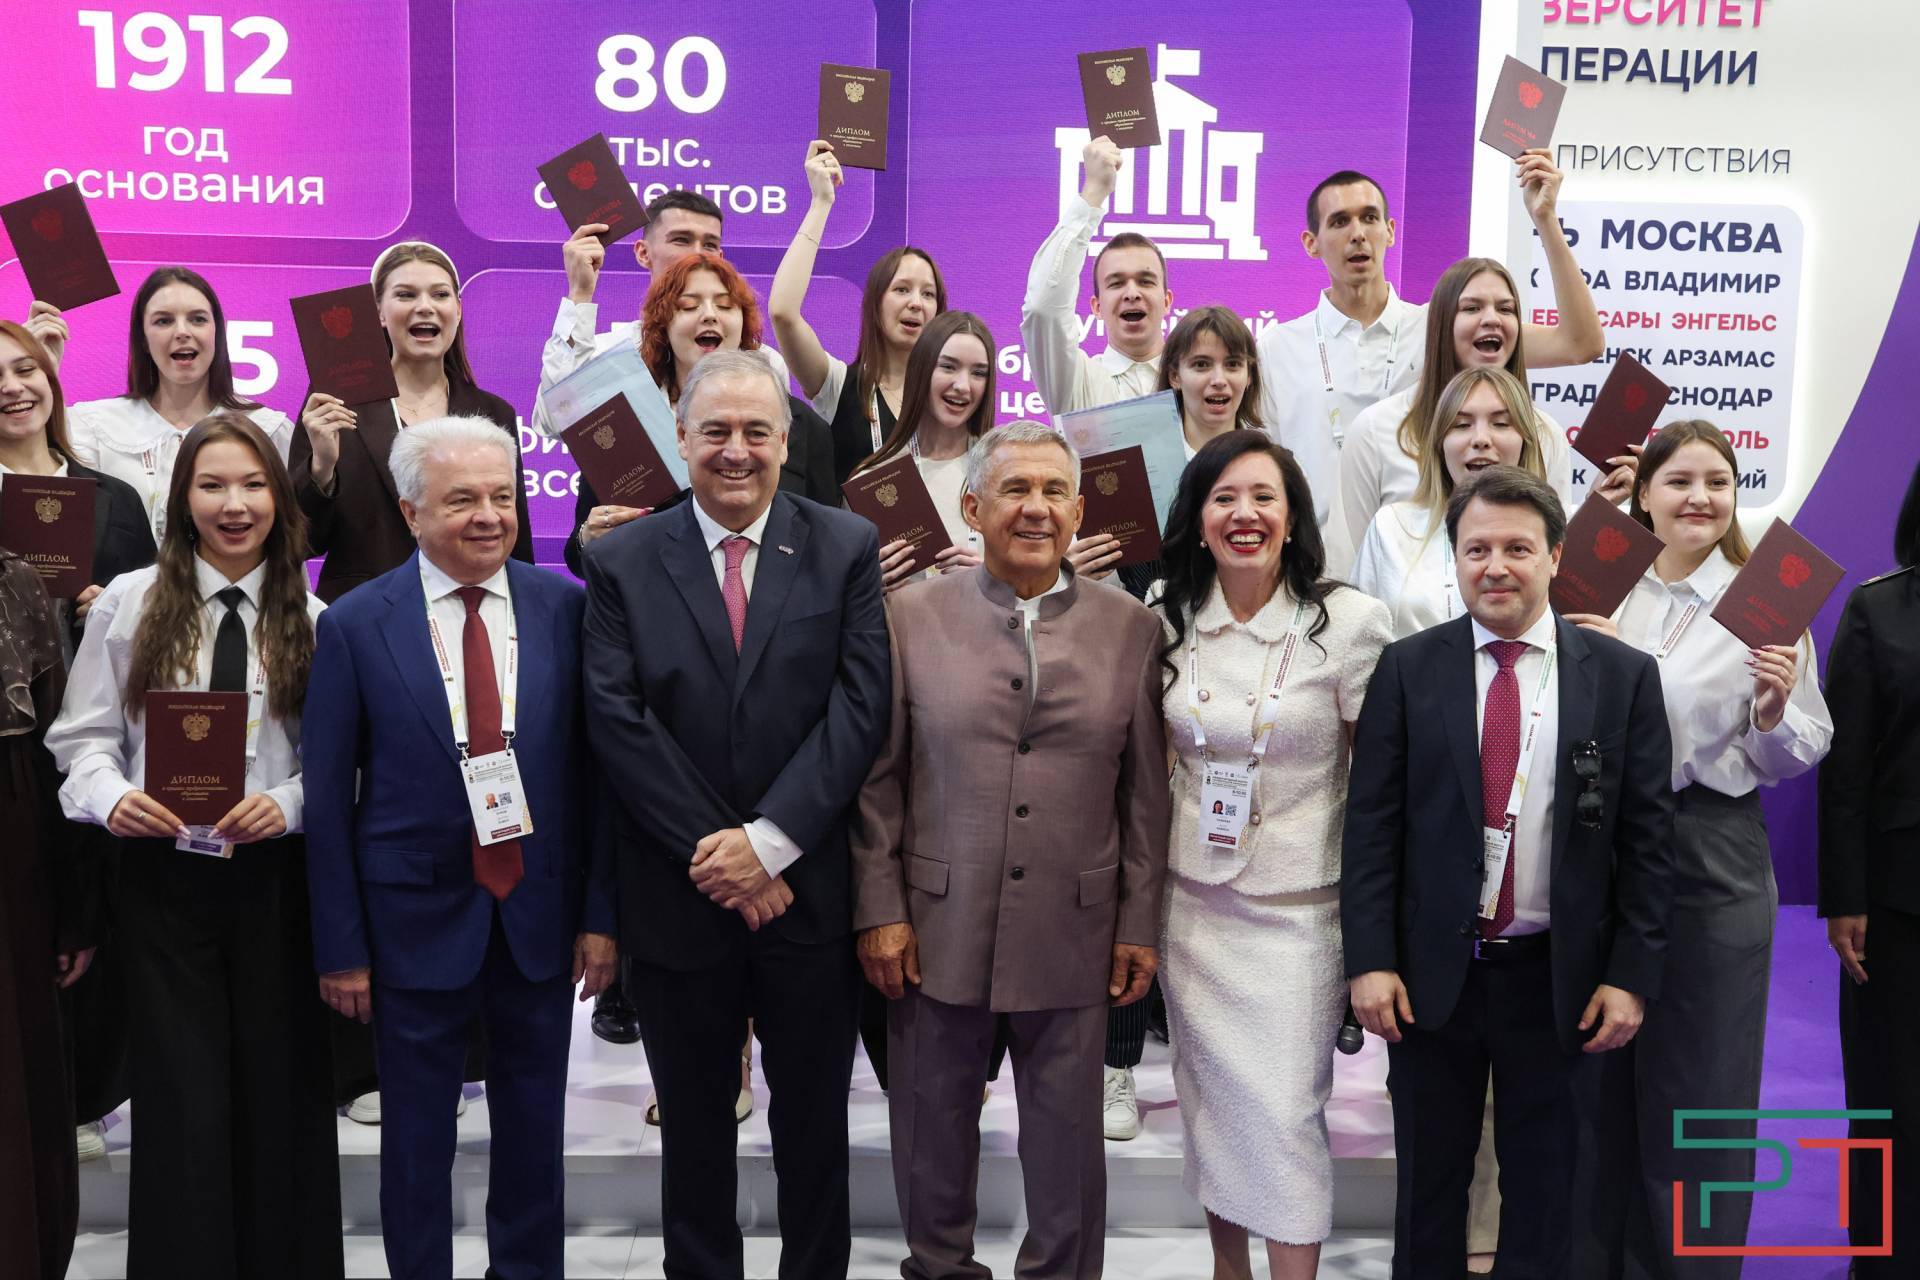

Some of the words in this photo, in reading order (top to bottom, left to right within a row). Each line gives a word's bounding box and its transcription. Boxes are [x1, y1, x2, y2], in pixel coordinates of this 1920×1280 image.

[78, 10, 292, 95] 1912
[594, 34, 728, 114] 80
[1105, 109, 1140, 120] ДИПЛОМ
[143, 126, 229, 162] год
[835, 126, 870, 137] ДИПЛОМ
[609, 137, 711, 168] тыс.
[1556, 144, 1791, 174] ПРИСУТСТВИЯ
[1601, 219, 1783, 254] МОСКВА
[1624, 270, 1781, 297] ВЛАДИМИР
[1671, 312, 1777, 332] ЭНГЕЛЬС
[1662, 350, 1776, 368] АРЗАМАС
[23, 553, 69, 563] ДИПЛОМ
[170, 775, 220, 785] ДИПЛОМ
